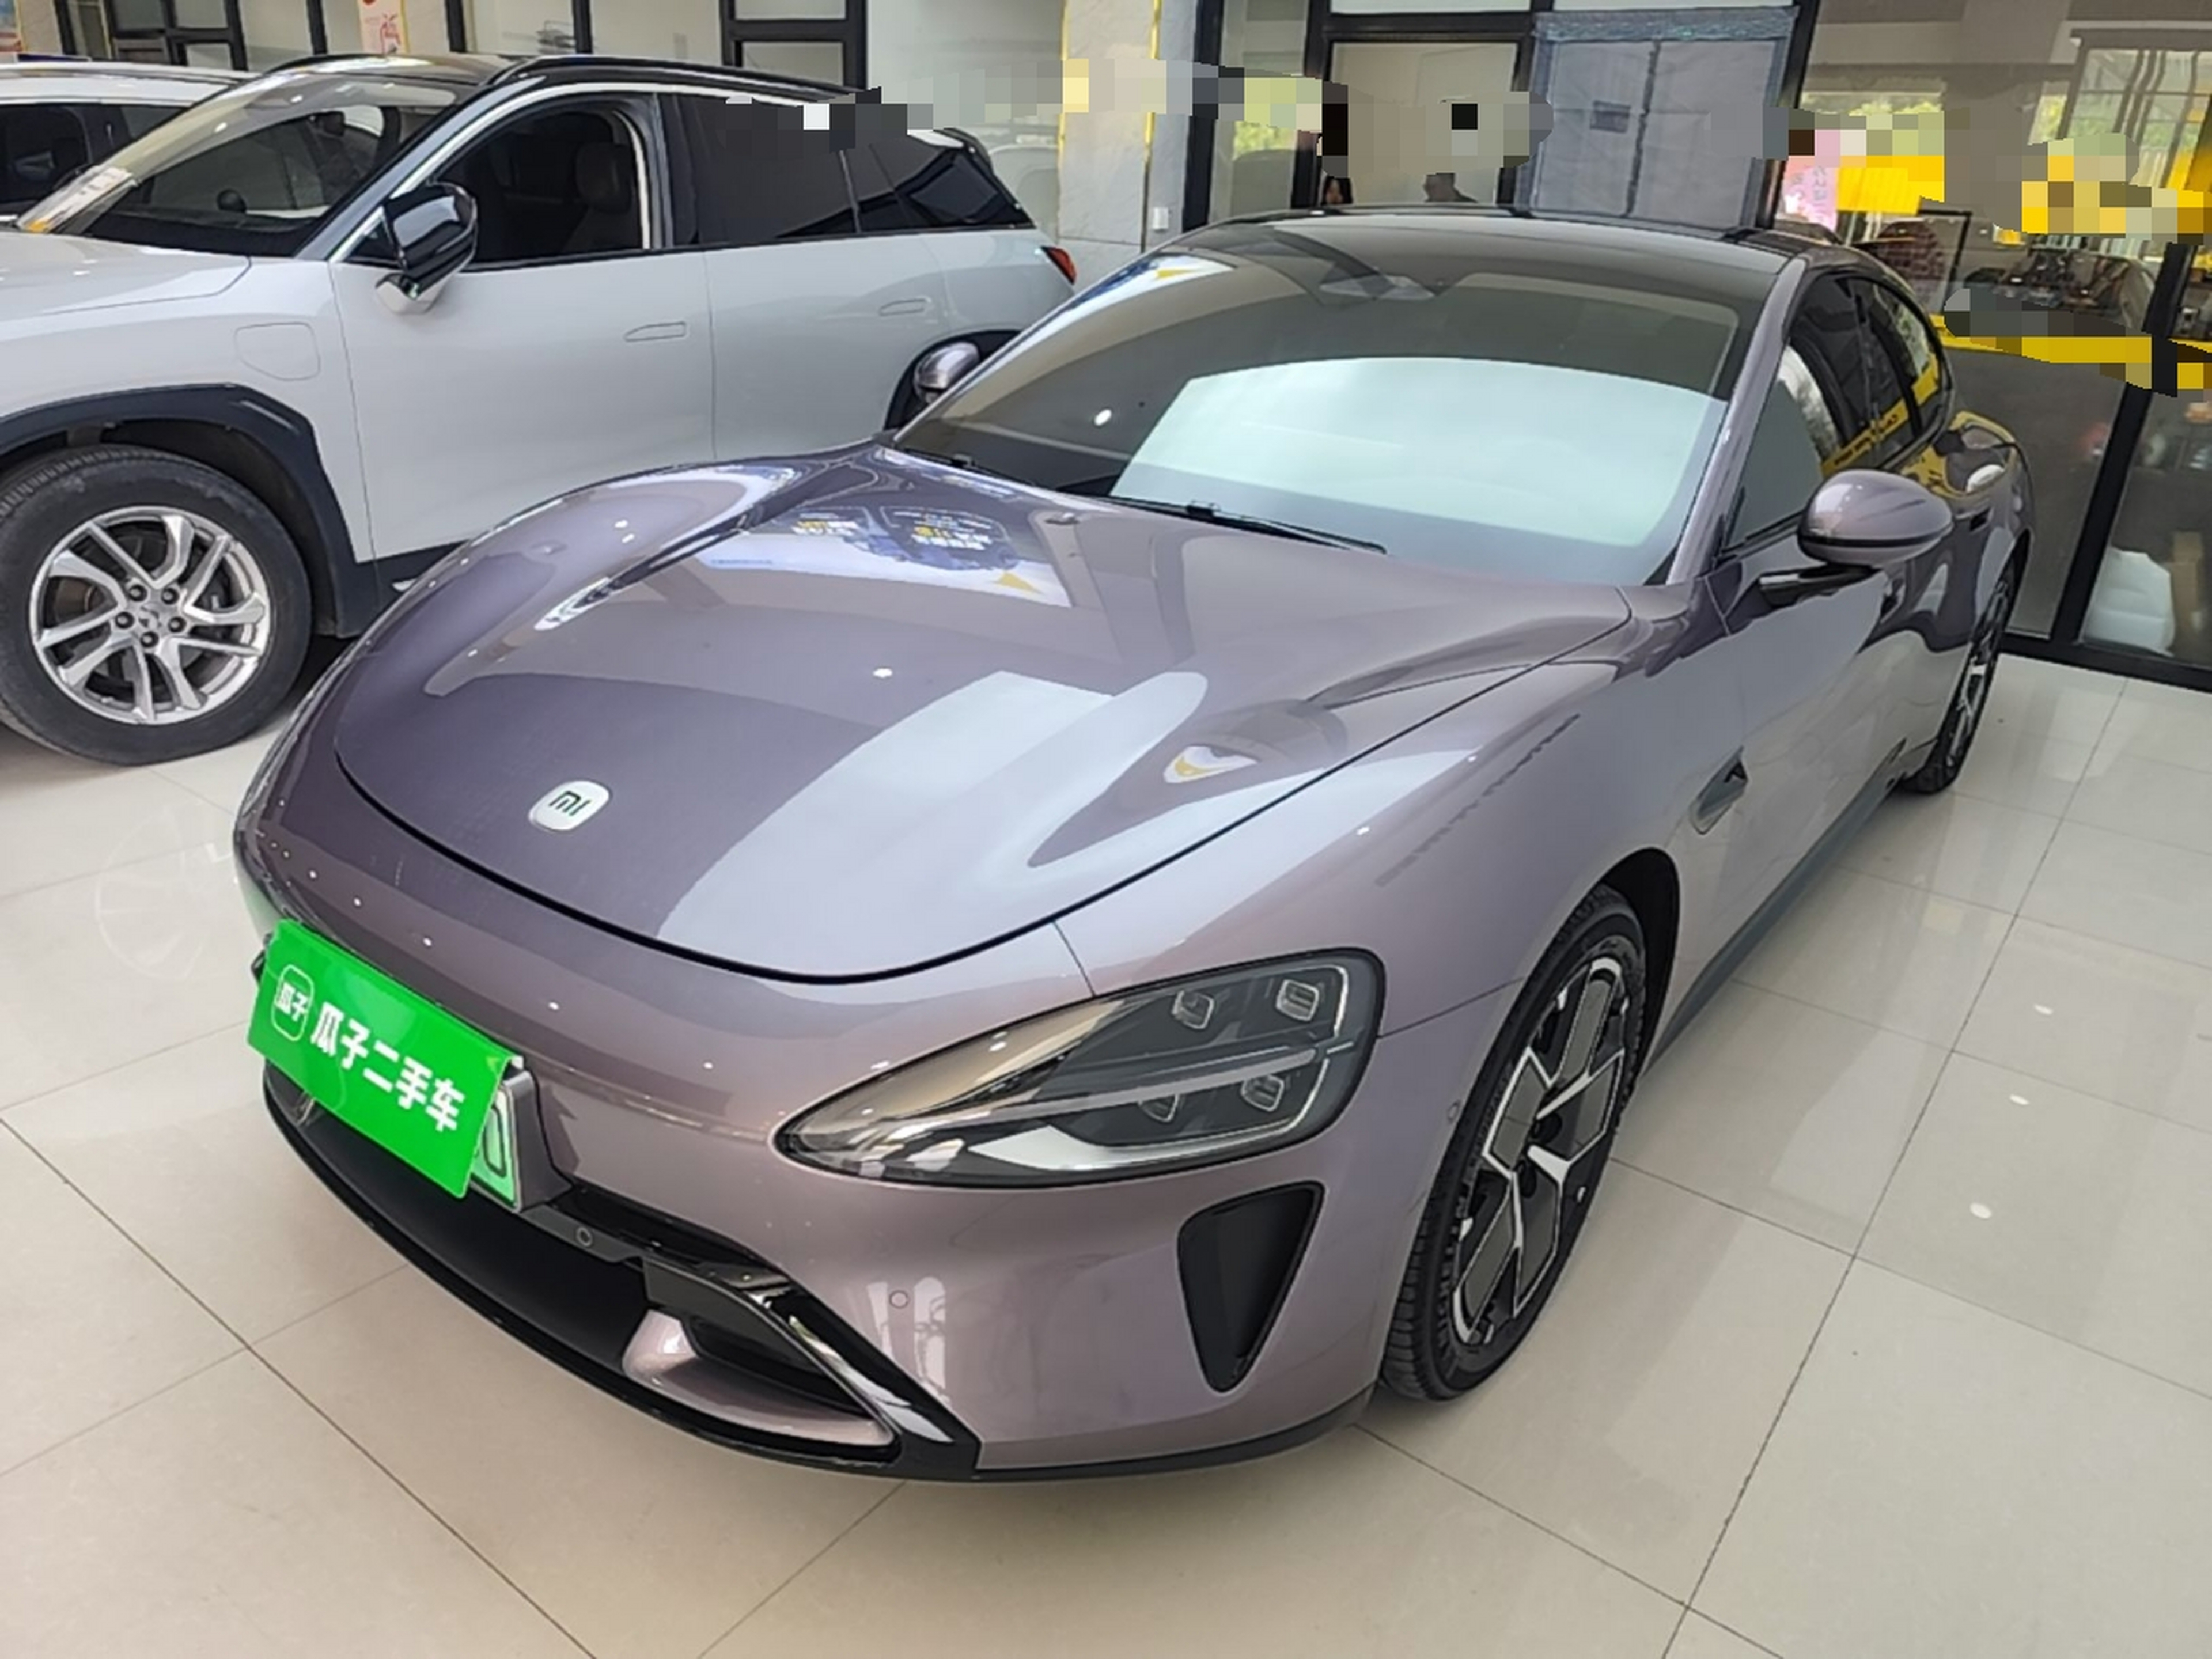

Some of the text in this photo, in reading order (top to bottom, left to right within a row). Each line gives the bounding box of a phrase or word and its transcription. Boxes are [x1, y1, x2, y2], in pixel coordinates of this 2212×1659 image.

[274, 982, 308, 1022] 瓜子
[310, 1001, 466, 1132] 瓜子二手车
